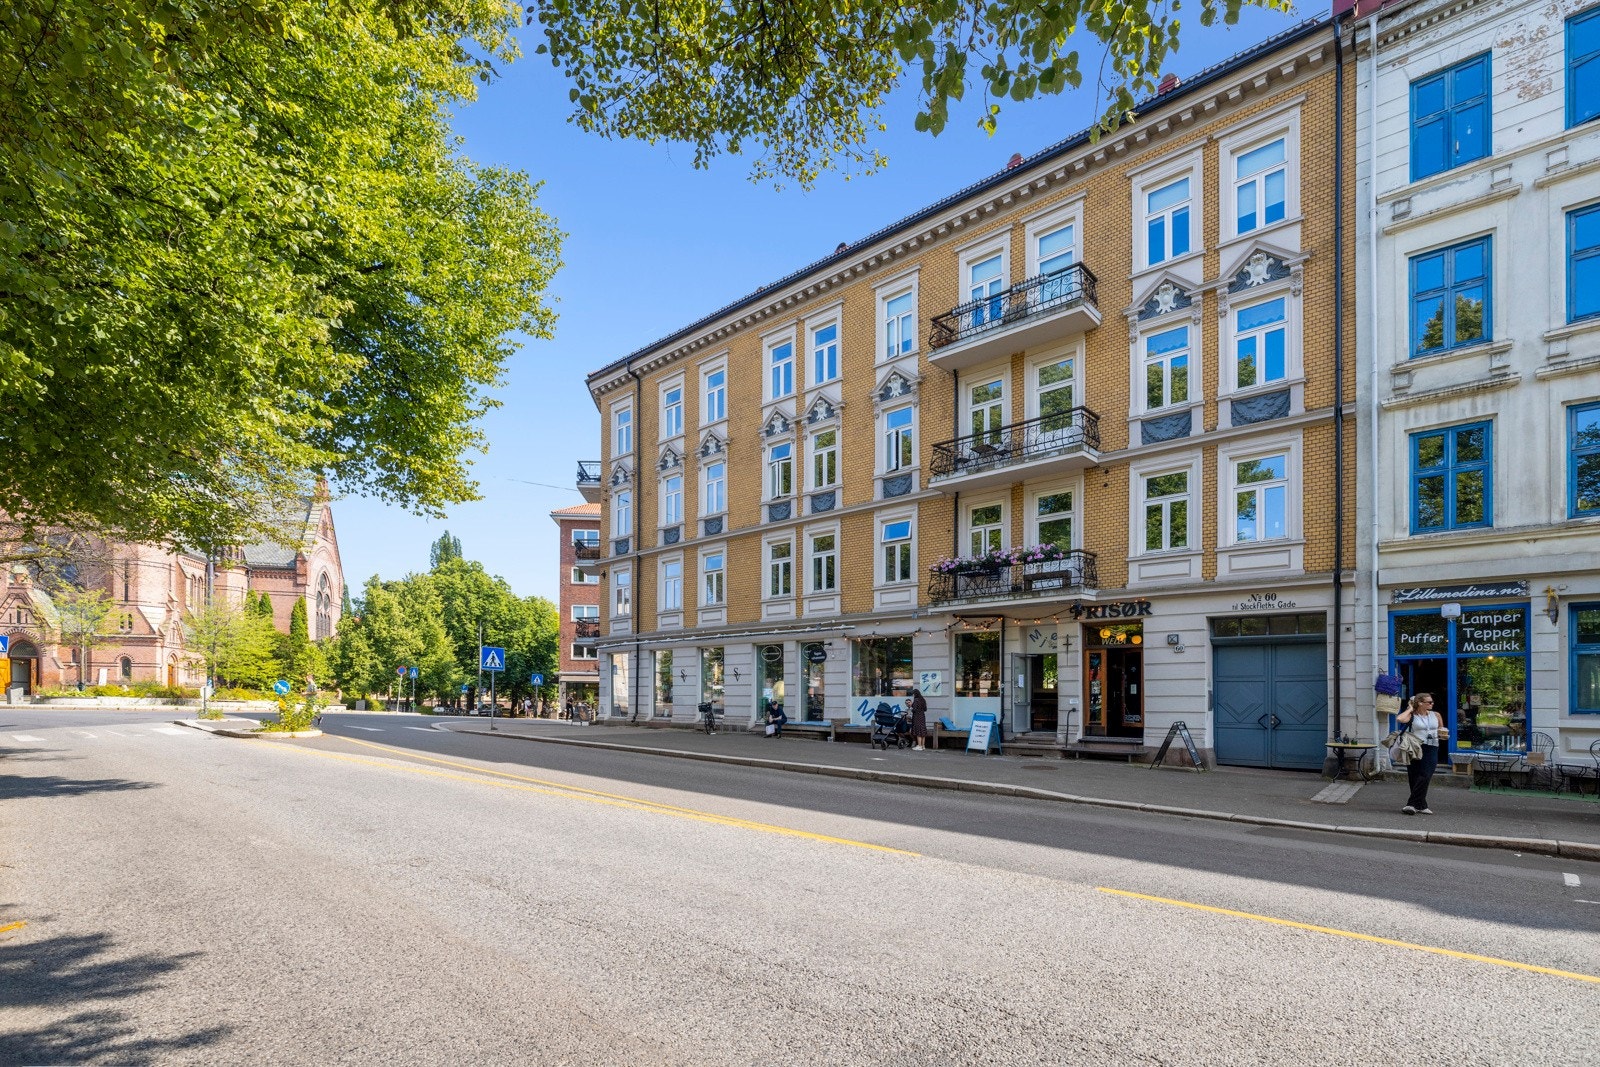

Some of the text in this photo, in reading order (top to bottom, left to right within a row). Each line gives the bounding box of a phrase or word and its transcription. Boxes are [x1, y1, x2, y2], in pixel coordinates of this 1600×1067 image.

[1264, 592, 1277, 602] 60
[1399, 586, 1521, 601] Lillemedina.no
[1240, 602, 1275, 611] Stockfleths
[1277, 600, 1296, 609] Gade
[1461, 613, 1521, 626] Lamper
[1401, 632, 1444, 644] Puffer
[1462, 628, 1520, 641] Tepper
[1462, 640, 1520, 652] Mosaikk
